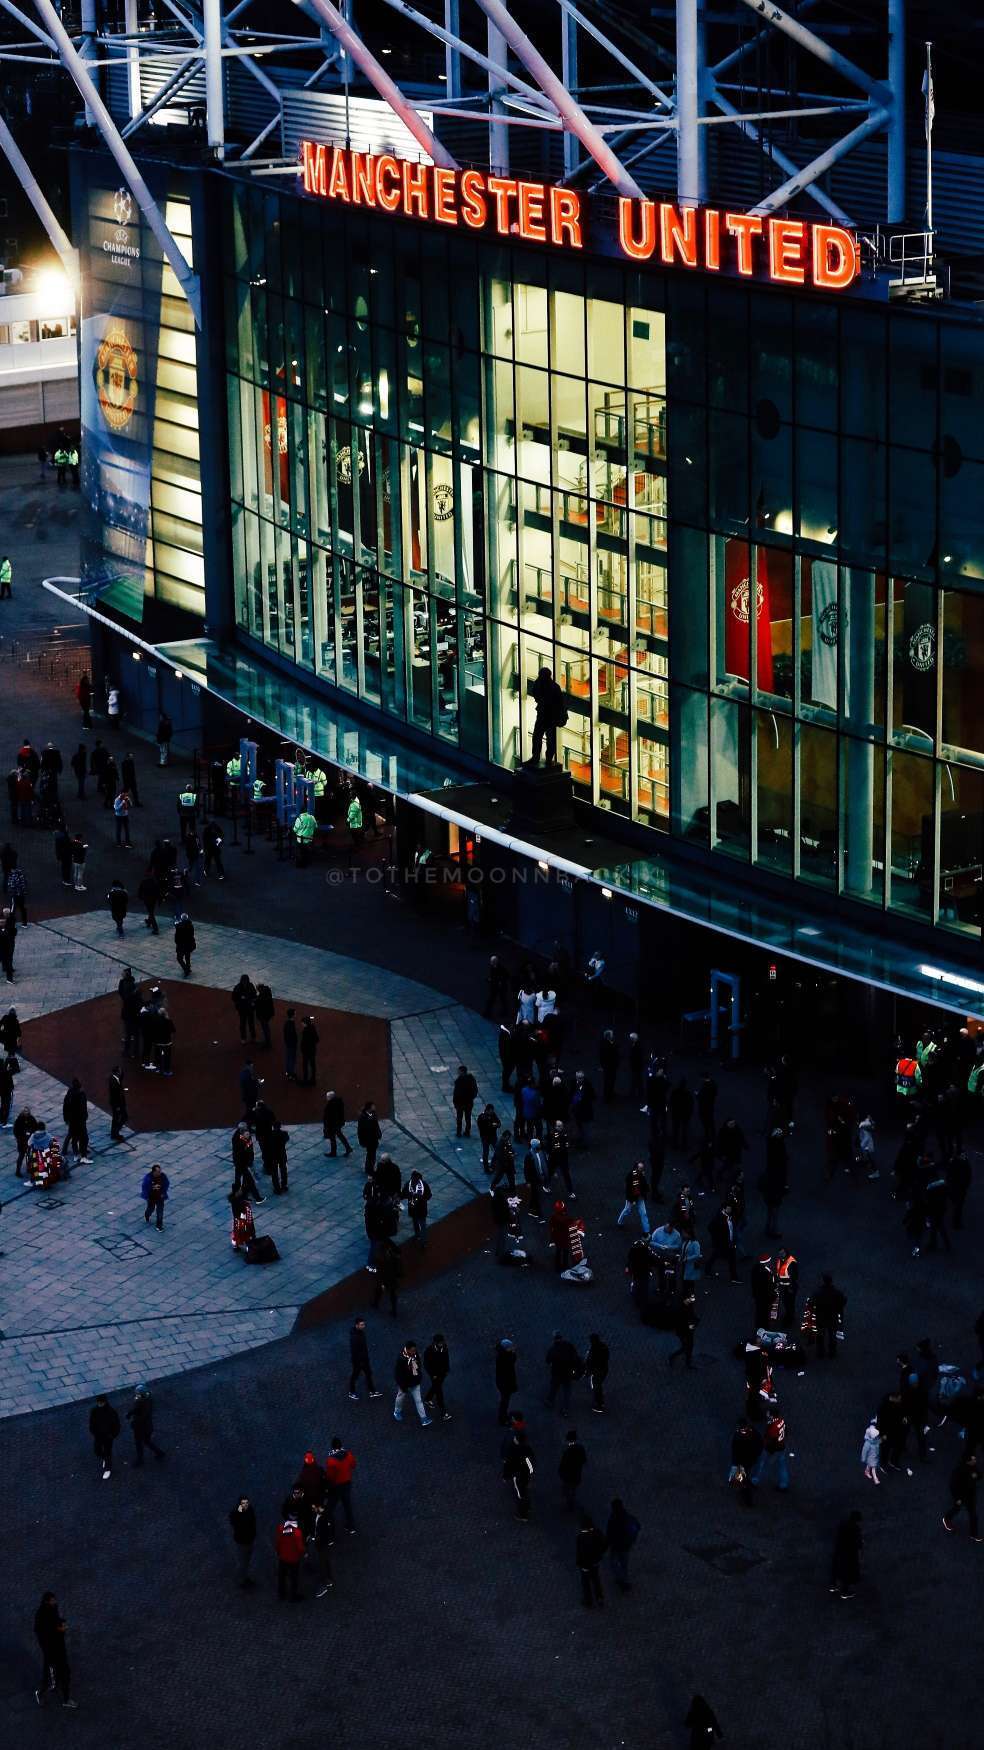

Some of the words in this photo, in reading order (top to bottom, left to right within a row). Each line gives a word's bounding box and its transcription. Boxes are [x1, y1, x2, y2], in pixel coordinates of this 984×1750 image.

[302, 140, 583, 248] MANCHESTER
[618, 197, 858, 288] UNITED
[103, 241, 140, 257] CHAMPIONS
[111, 255, 131, 266] LEAGUE
